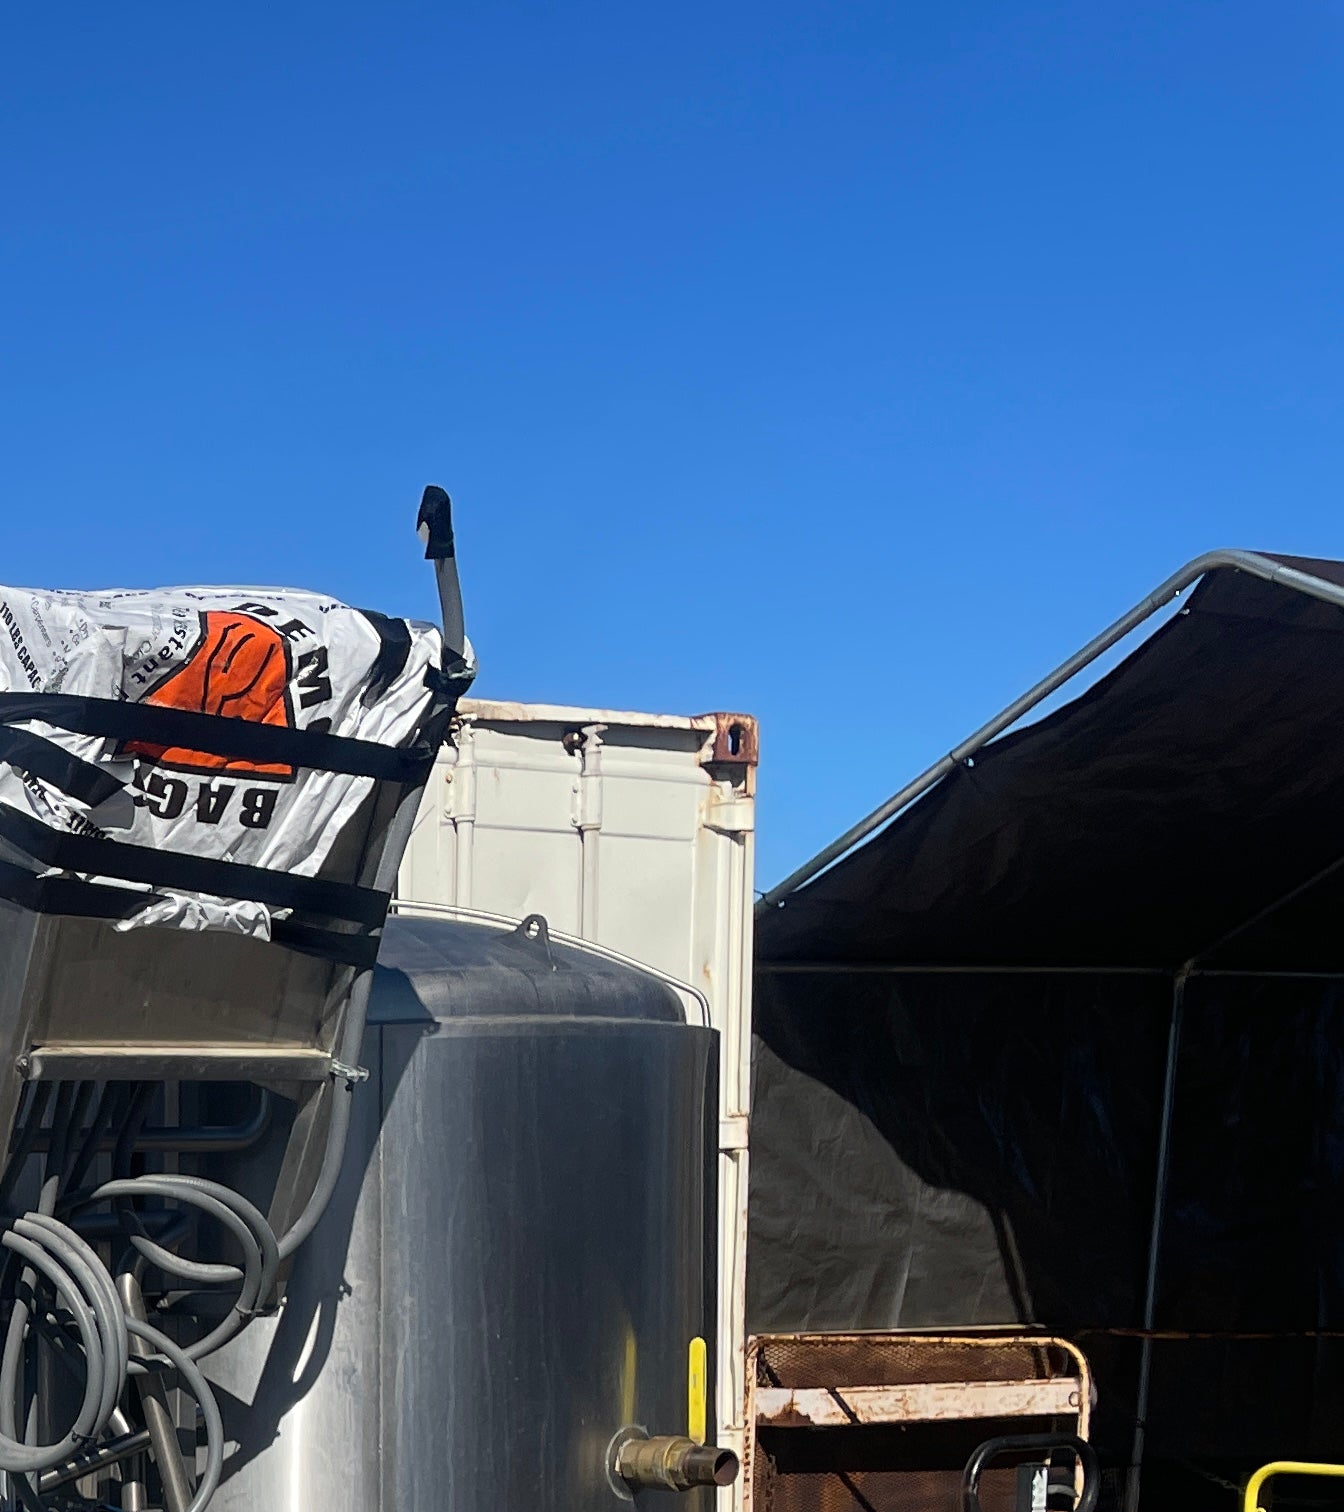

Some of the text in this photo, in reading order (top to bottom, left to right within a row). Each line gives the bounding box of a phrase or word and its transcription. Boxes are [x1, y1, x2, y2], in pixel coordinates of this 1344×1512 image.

[0, 601, 42, 689] 110 LBS CAPAC
